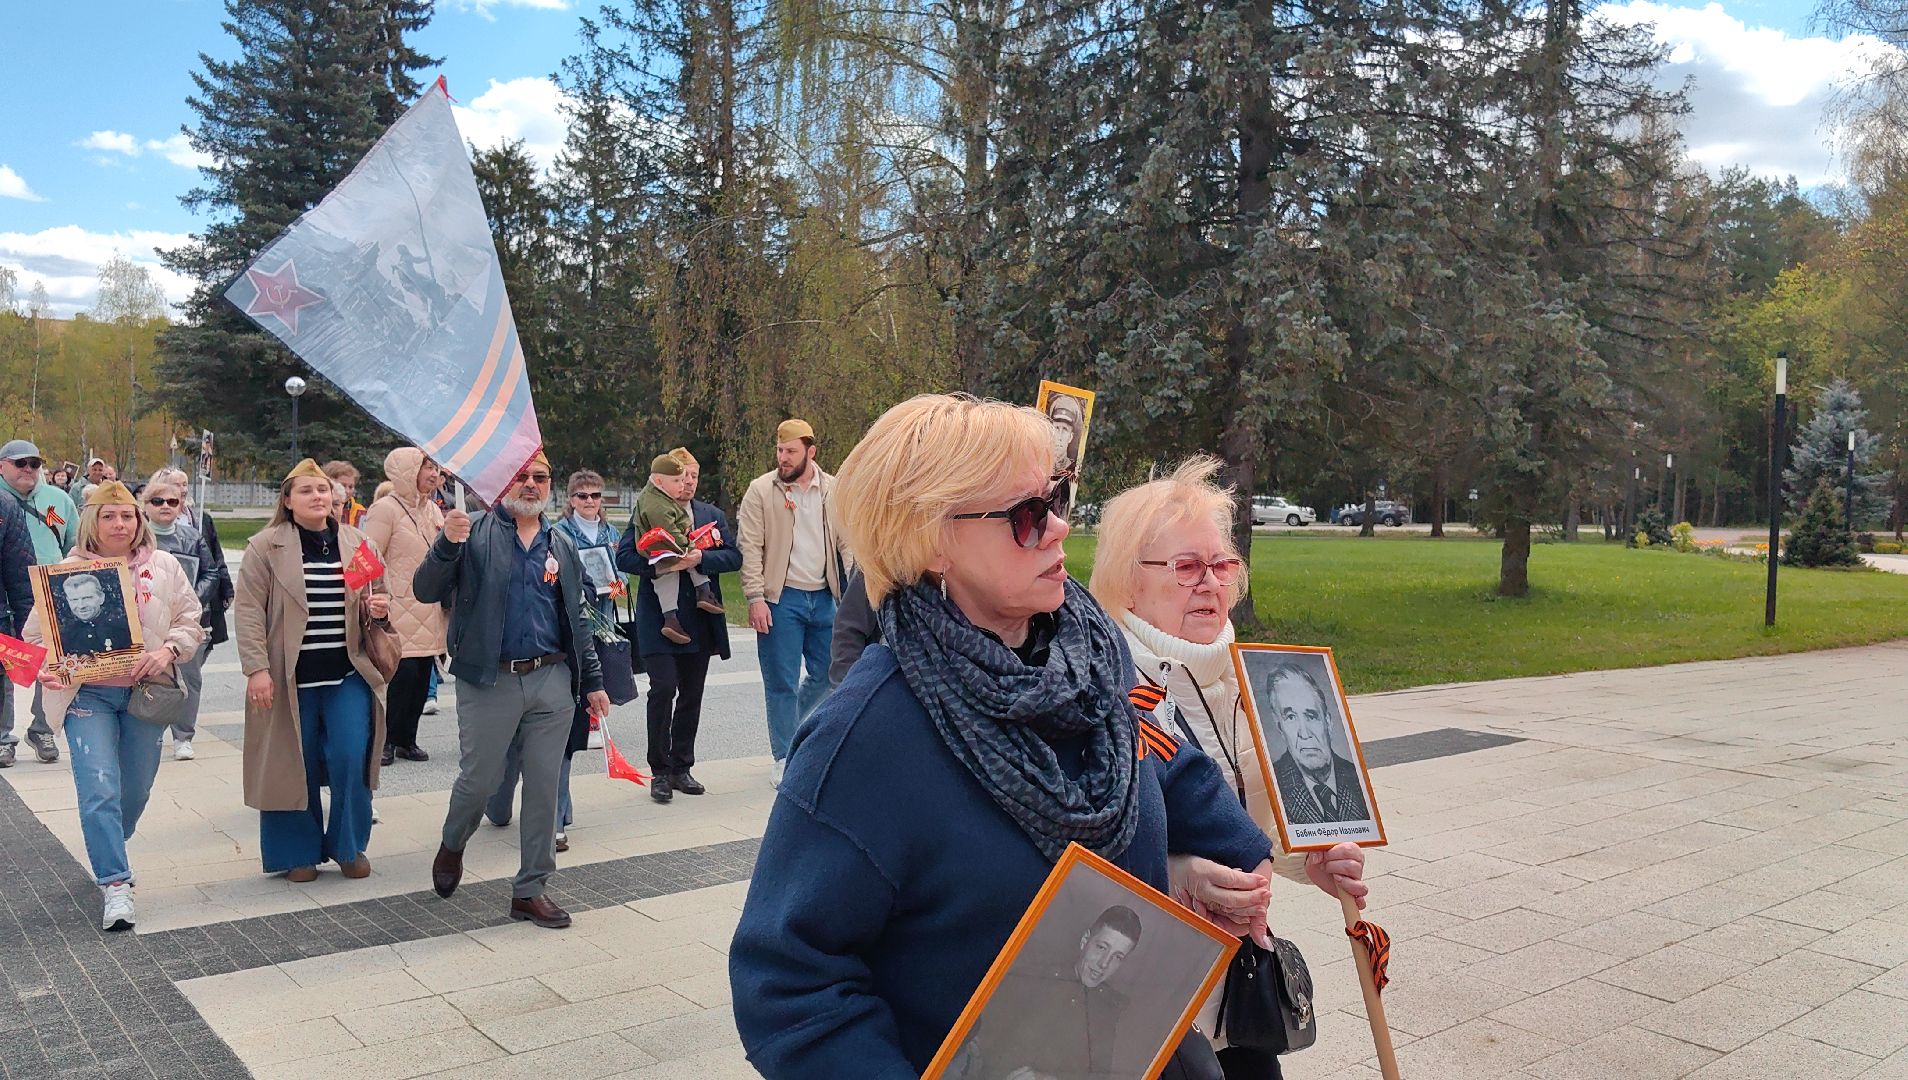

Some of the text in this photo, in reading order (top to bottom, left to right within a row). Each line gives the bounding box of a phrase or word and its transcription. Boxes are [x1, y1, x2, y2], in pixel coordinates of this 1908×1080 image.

[1295, 826, 1370, 838] Бабин Фёдор Иванович
